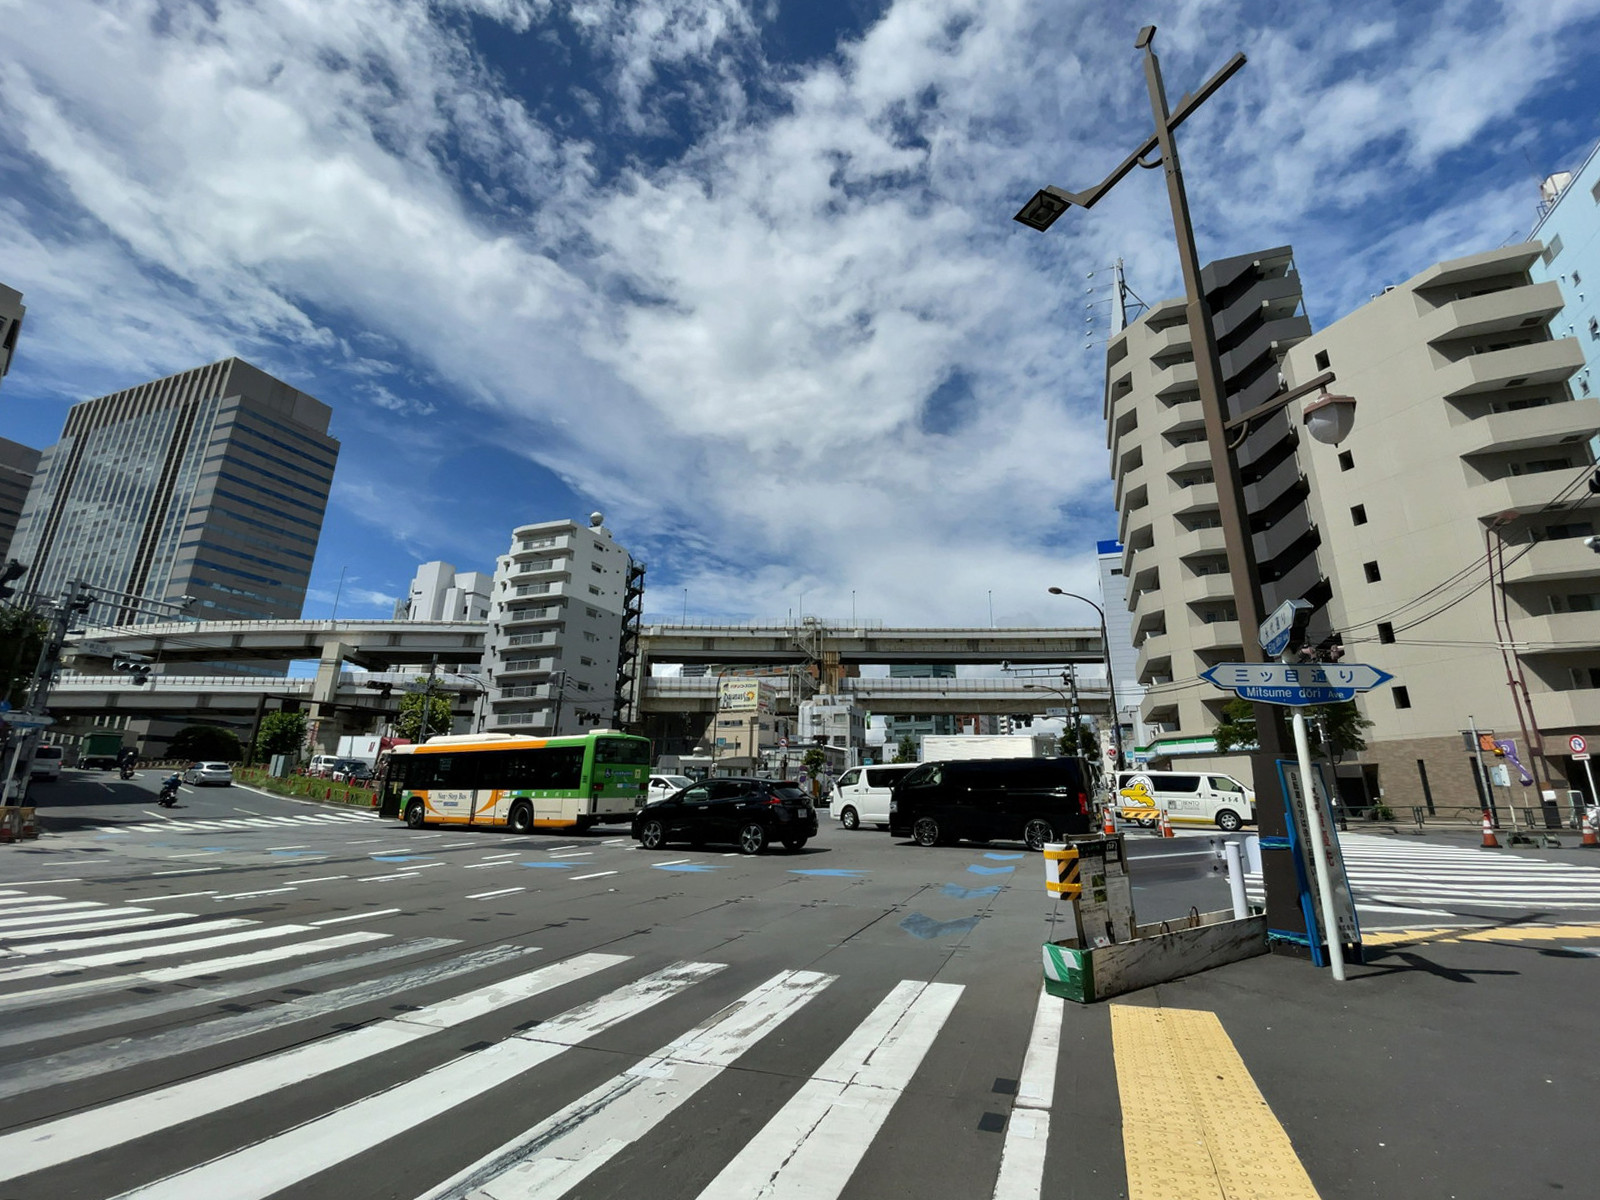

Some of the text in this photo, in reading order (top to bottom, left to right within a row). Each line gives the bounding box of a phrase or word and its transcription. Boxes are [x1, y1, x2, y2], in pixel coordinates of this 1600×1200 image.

[1235, 669, 1353, 683] 三ツ目通り
[1246, 688, 1292, 698] Mitsume
